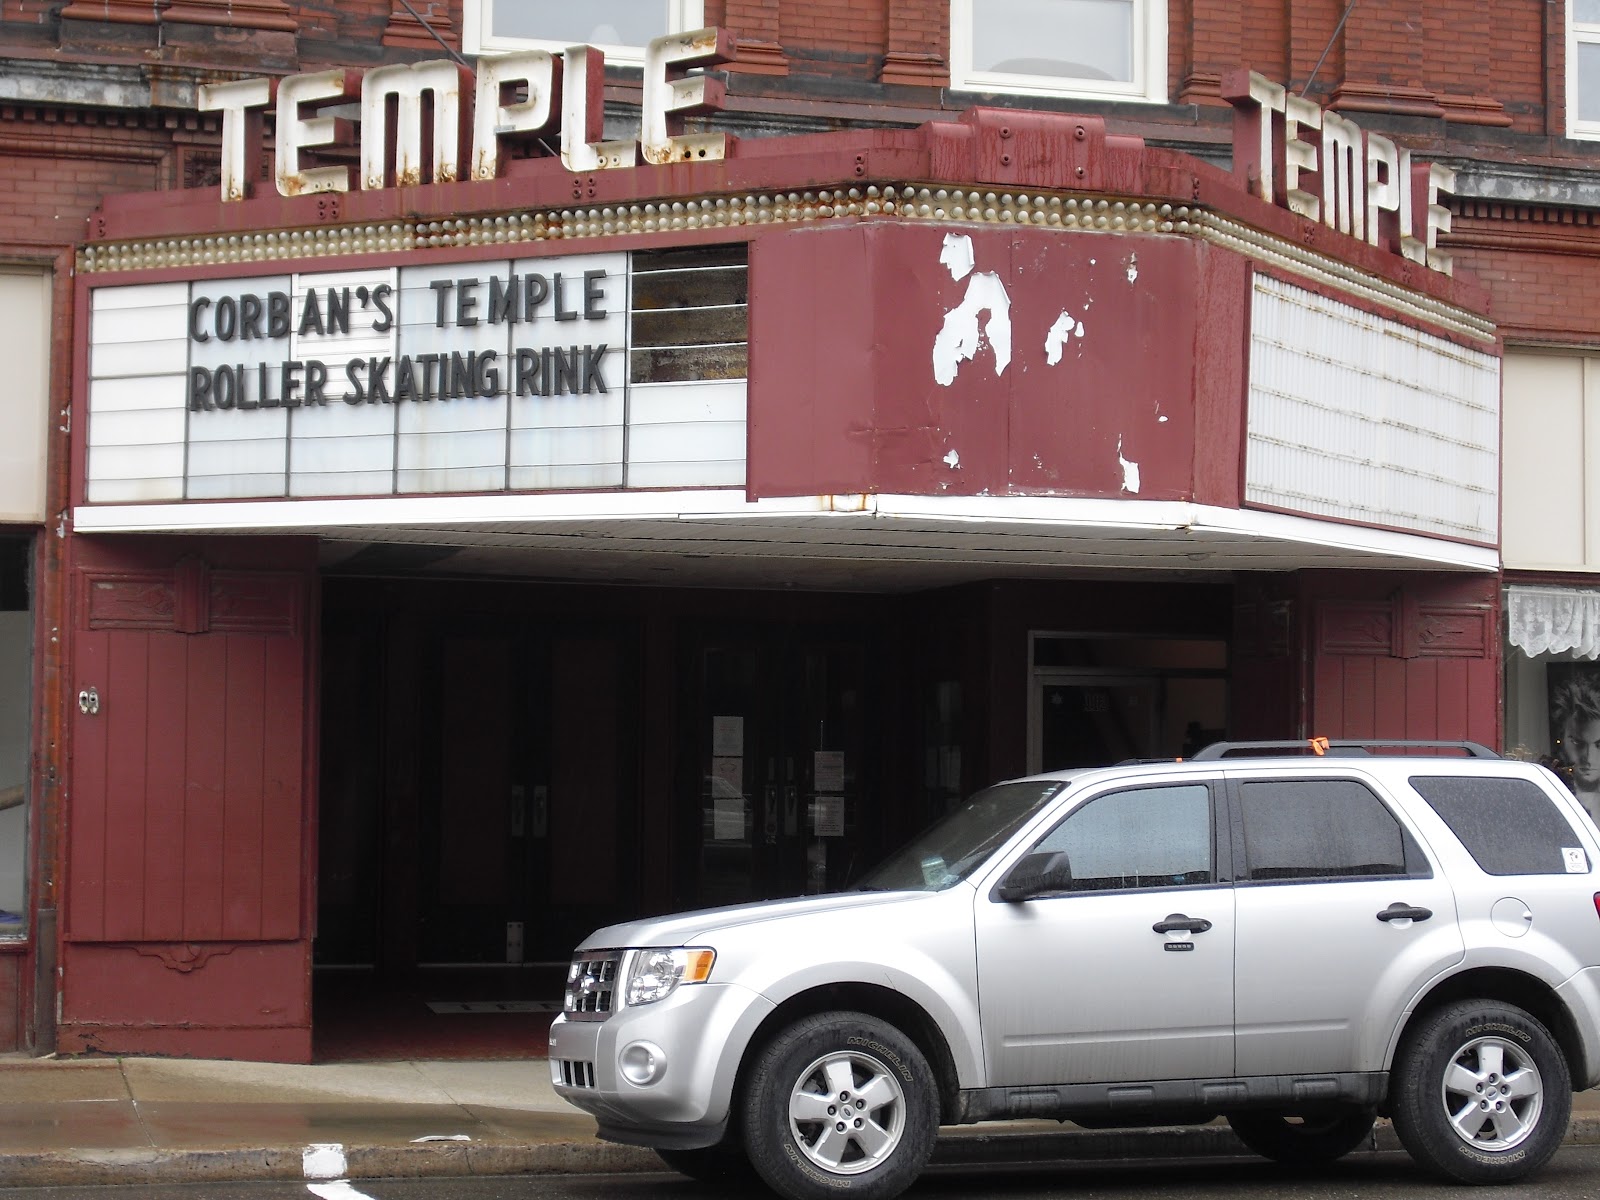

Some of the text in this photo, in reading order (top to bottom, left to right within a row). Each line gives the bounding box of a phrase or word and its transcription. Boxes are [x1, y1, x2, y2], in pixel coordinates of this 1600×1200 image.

[198, 28, 732, 202] TEMPLE
[1245, 70, 1456, 278] TEMPLE
[188, 268, 608, 344] CORBAN'S TEMPLE
[189, 343, 608, 413] ROLLER SKATING RINK
[846, 1036, 914, 1082] MICHELIN
[1465, 1022, 1532, 1043] MICHELIN
[784, 1143, 852, 1188] MICHELIN
[1459, 1145, 1526, 1165] MICHELIN
